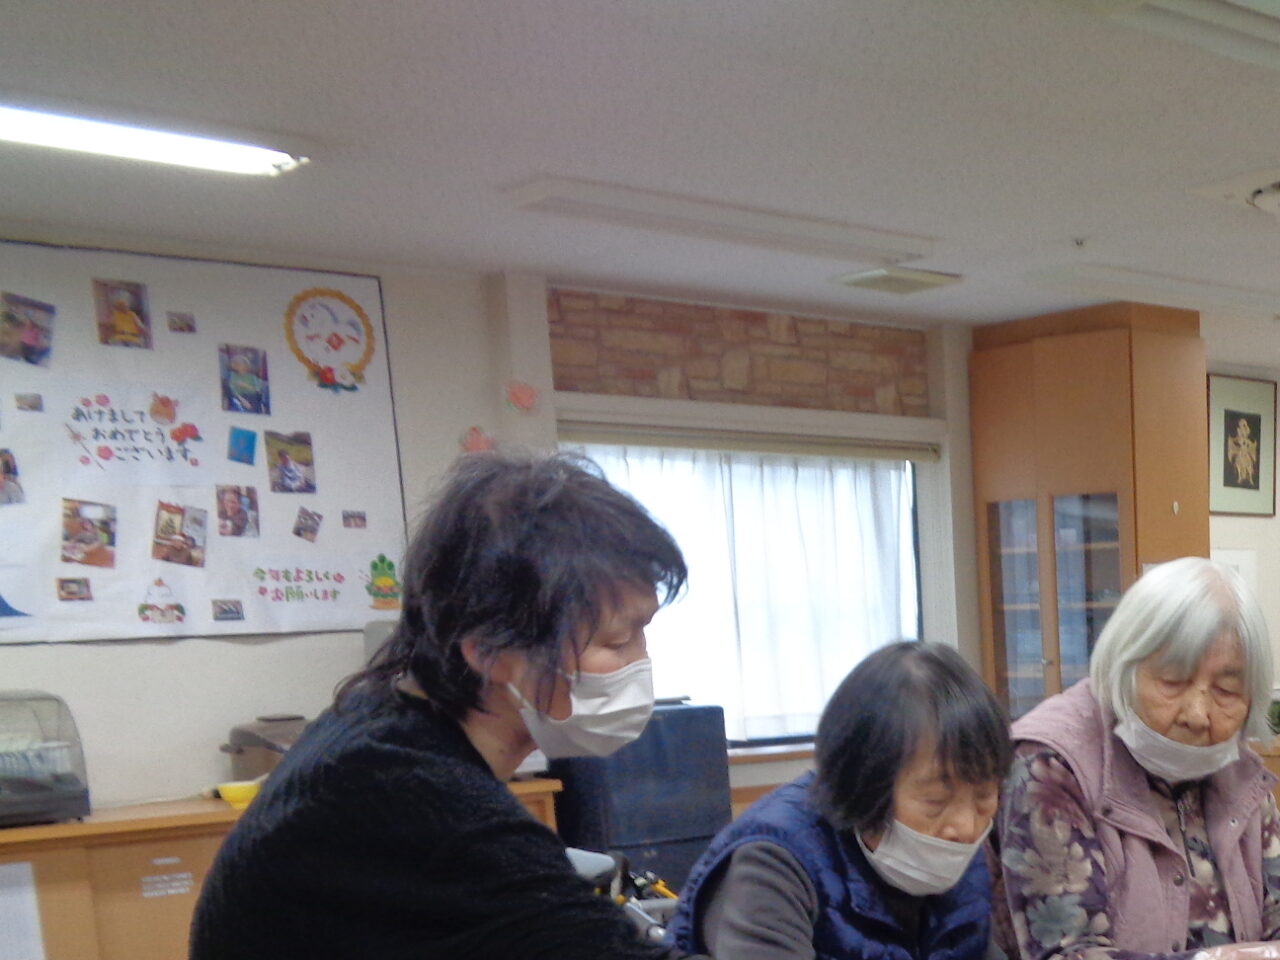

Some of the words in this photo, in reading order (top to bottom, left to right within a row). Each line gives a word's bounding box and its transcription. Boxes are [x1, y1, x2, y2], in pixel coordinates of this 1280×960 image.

[72, 406, 146, 423] あけまして
[92, 426, 165, 443] おめでとう
